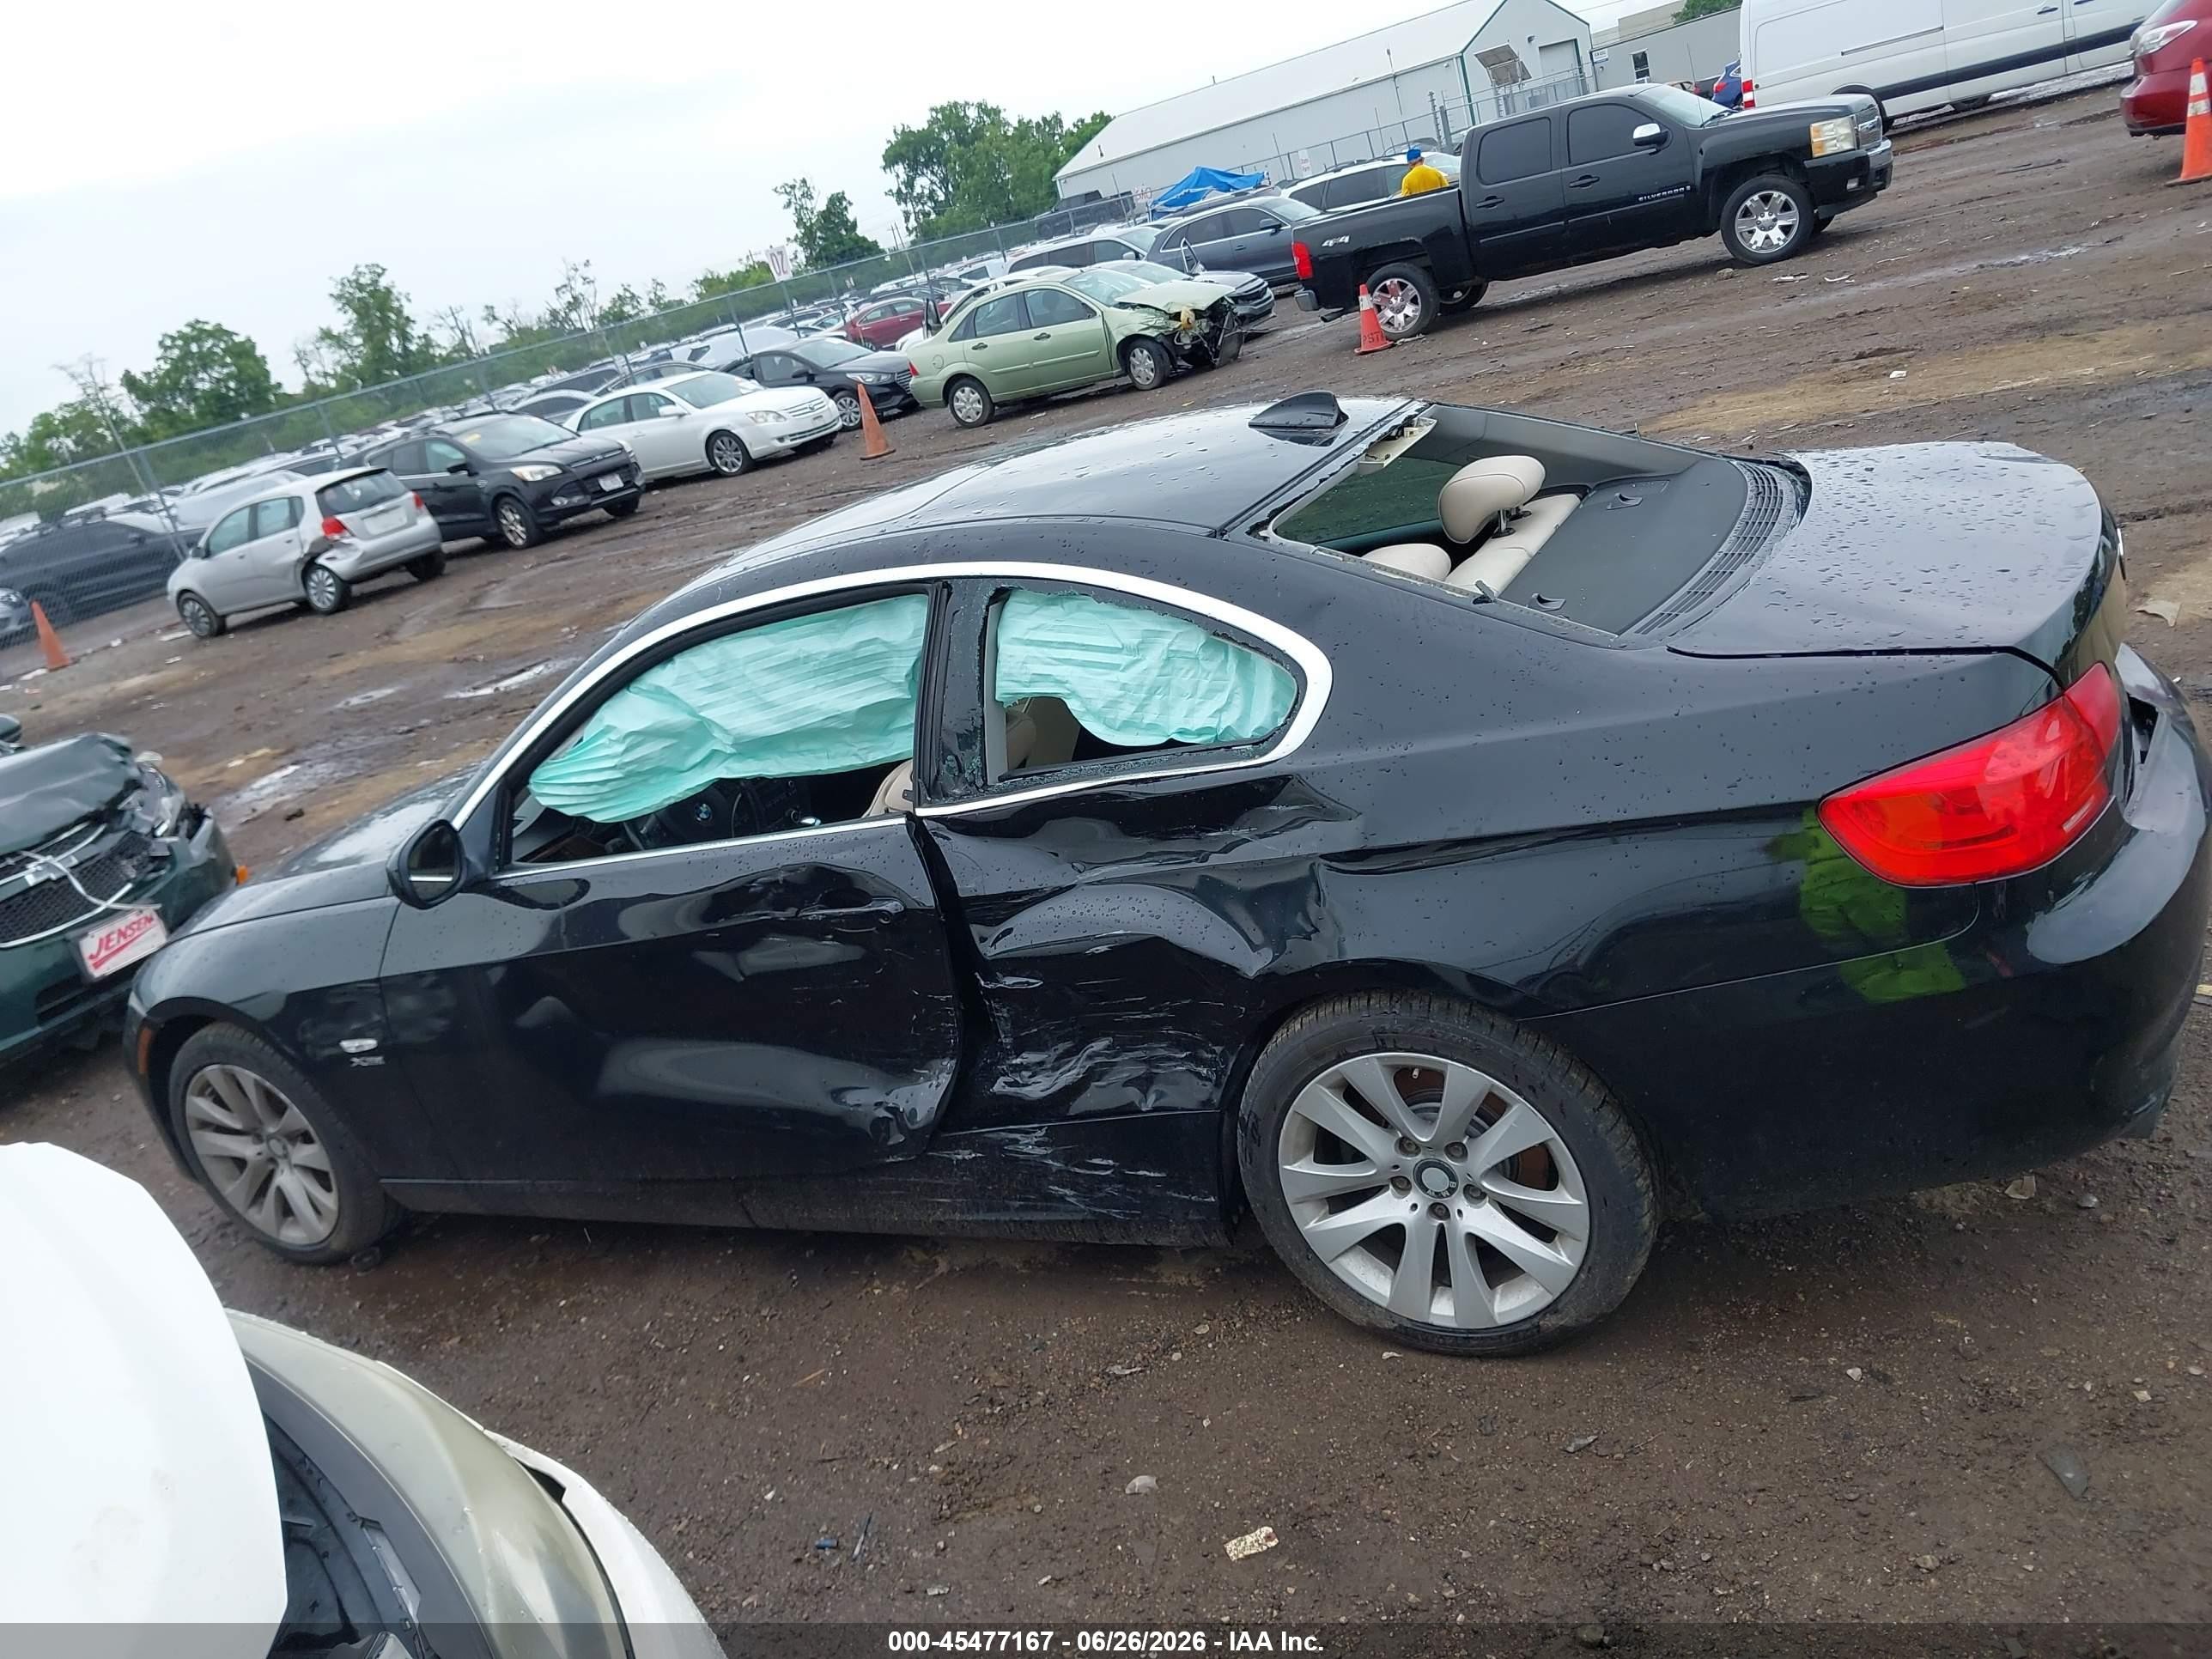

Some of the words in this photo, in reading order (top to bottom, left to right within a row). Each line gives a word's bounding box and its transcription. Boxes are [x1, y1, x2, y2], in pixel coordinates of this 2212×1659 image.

[1638, 187, 1685, 201] SILVERADO
[89, 916, 154, 959] JENSEN
[1427, 1182, 1456, 1197] BMW
